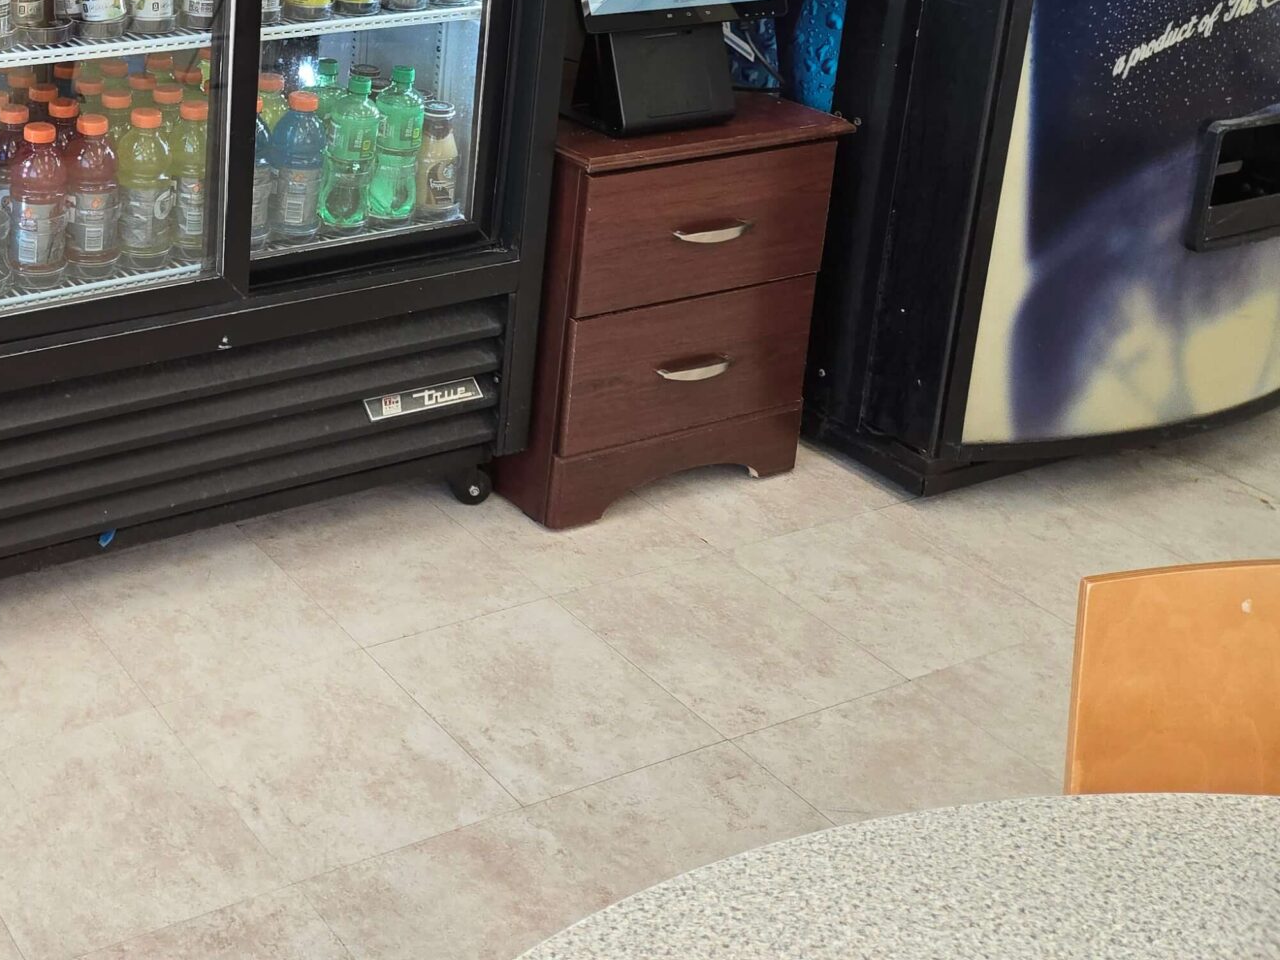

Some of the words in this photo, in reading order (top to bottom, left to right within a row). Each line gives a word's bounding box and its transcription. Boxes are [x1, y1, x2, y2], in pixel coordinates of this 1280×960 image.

[1112, 54, 1126, 77] a
[1122, 15, 1198, 80] product
[1197, 2, 1223, 38] of
